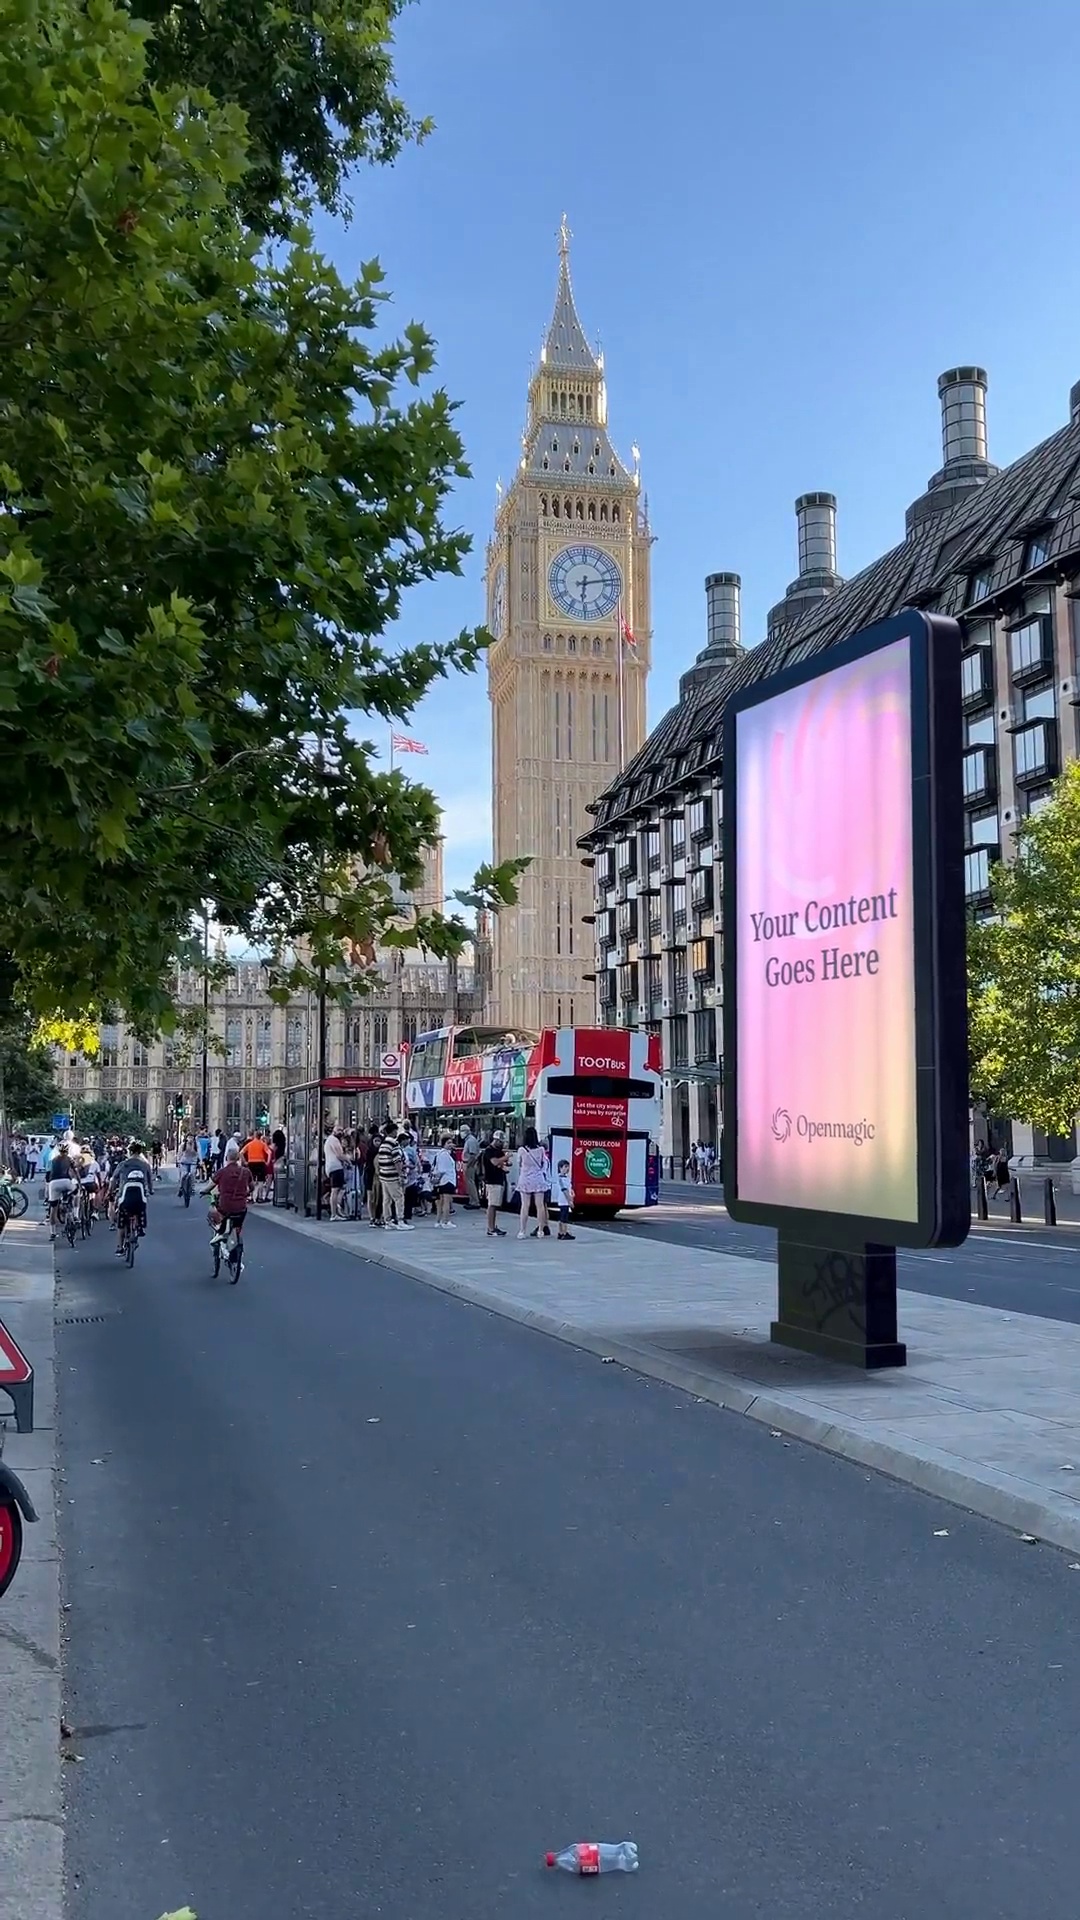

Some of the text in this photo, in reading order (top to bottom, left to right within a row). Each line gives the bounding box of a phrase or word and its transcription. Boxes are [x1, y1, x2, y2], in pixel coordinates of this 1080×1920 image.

[750, 888, 898, 942] Your Content
[765, 948, 879, 987] Goes Here
[400, 1042, 409, 1052] K
[578, 1056, 626, 1070] TOOTBUS
[606, 1103, 625, 1111] simply
[796, 1114, 876, 1147] Openmagic
[580, 1140, 621, 1148] TOOTBUS.COM
